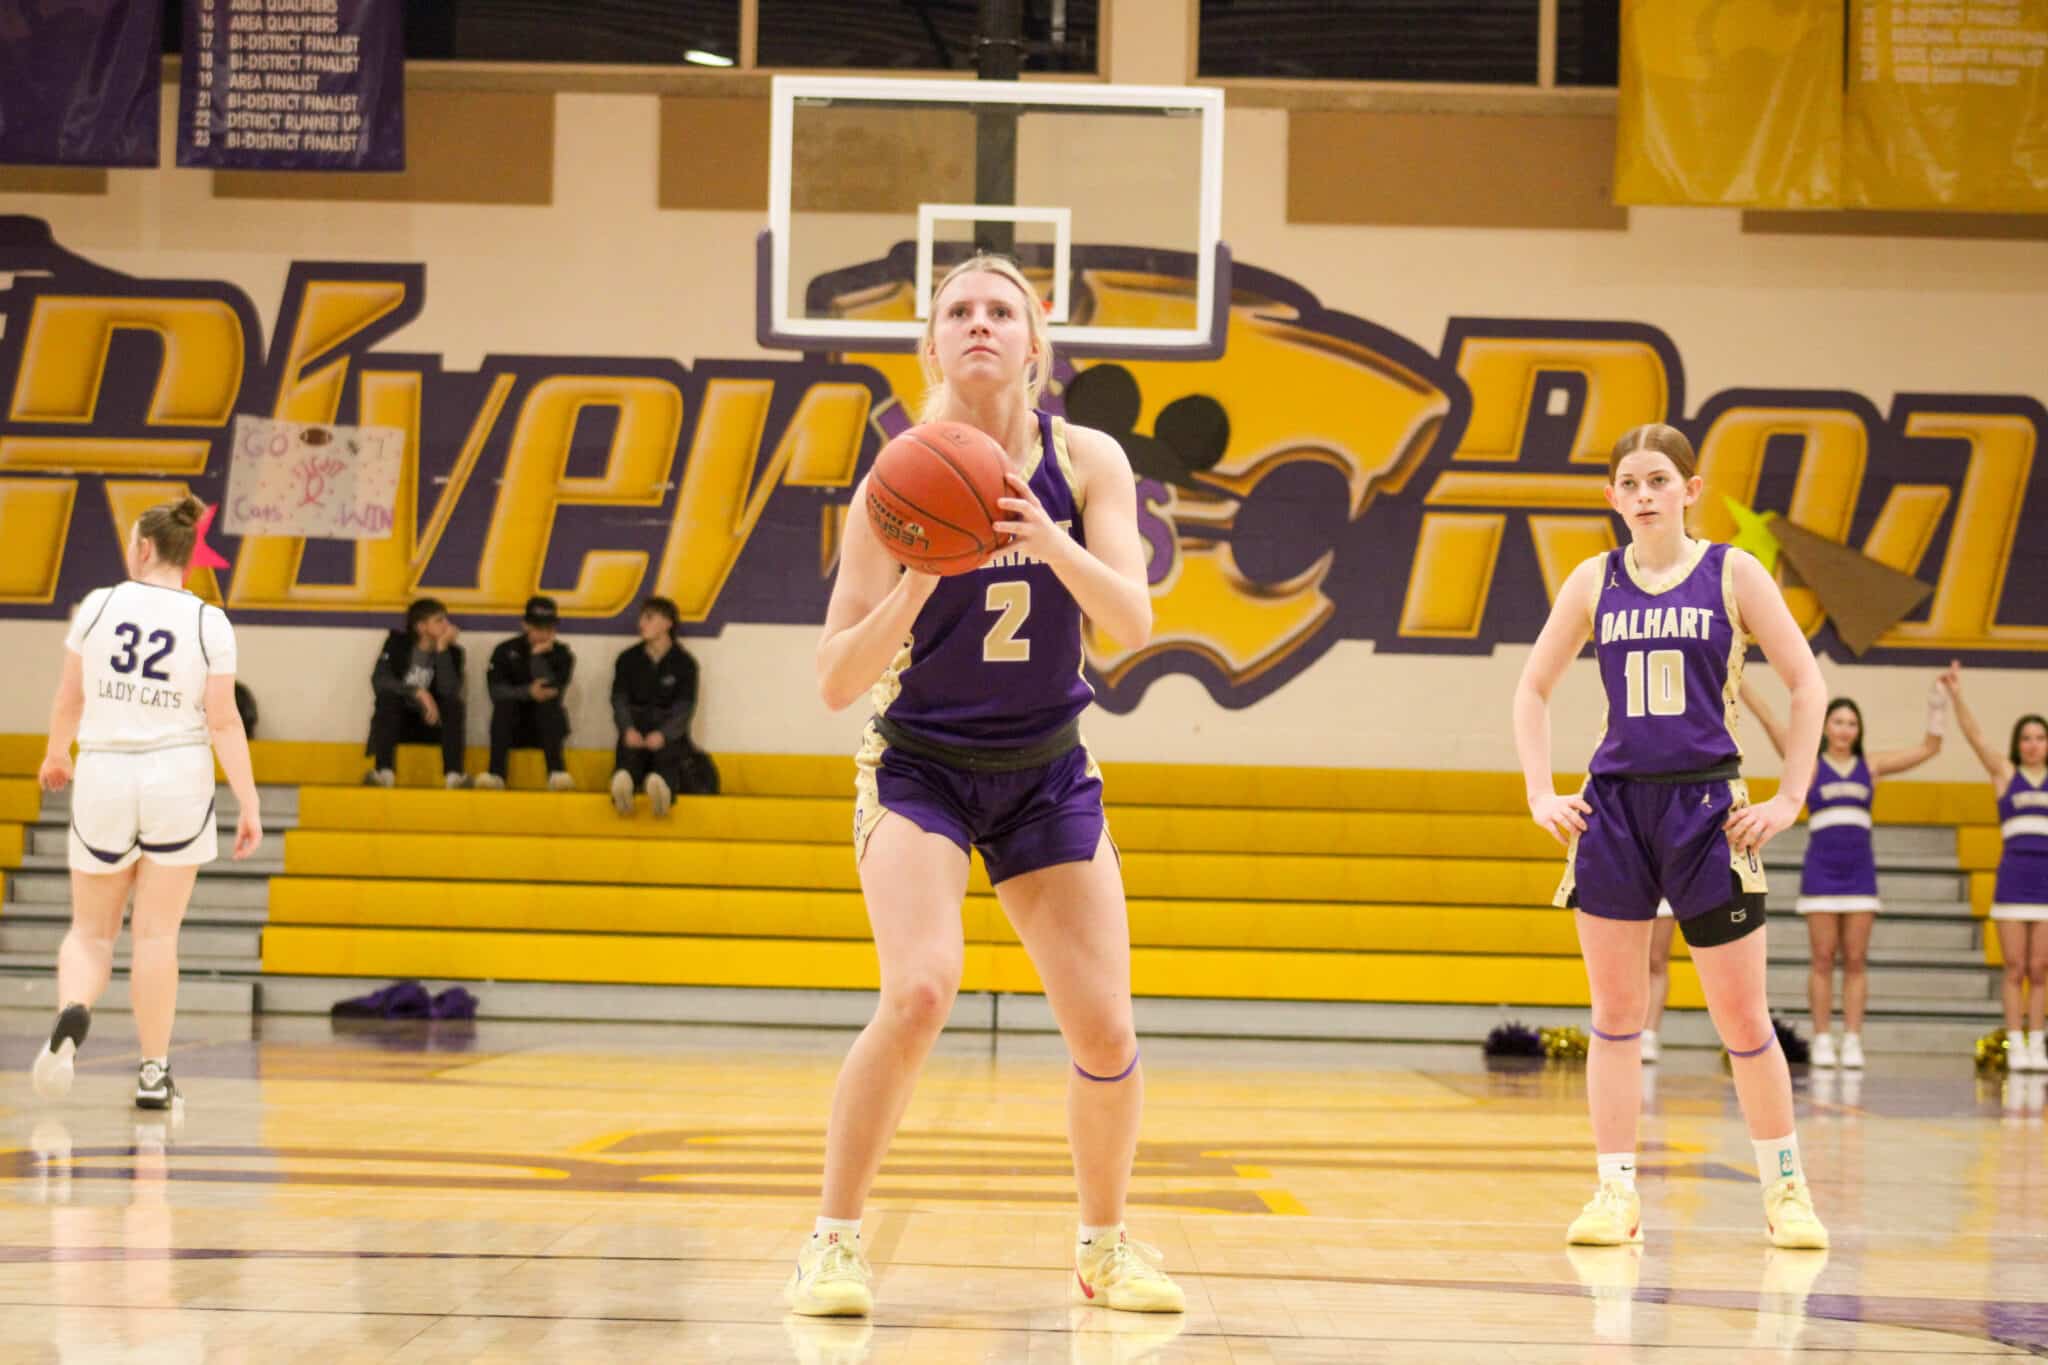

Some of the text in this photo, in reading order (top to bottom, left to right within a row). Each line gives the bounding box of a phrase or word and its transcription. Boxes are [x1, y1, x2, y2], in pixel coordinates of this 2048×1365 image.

[229, 0, 263, 12] AREA
[269, 0, 338, 13] QUALIFIERS
[229, 15, 263, 31] AREA
[269, 16, 338, 33] QUALIFIERS
[201, 33, 360, 54] 17 BI-DISTRICT FINALIST
[229, 54, 301, 71] BI-DISTRICT
[305, 55, 360, 73] FINALIST
[229, 74, 263, 89] AREA
[265, 75, 320, 91] FINALIST
[198, 92, 359, 112] 21 BI-DISTRICT FINALIST
[228, 112, 281, 130] DISTRICT
[286, 113, 339, 131] RUNNER
[343, 114, 361, 131] UP
[227, 131, 300, 150] BI-DISTRICT
[303, 133, 359, 152] FINALIST
[242, 429, 289, 458] GO
[338, 503, 395, 531] WIN
[982, 580, 1032, 663] 2
[1600, 606, 1715, 646] DALHART
[110, 621, 176, 682] 32
[1623, 649, 1688, 718] 10
[98, 679, 184, 710] LADY CATS
